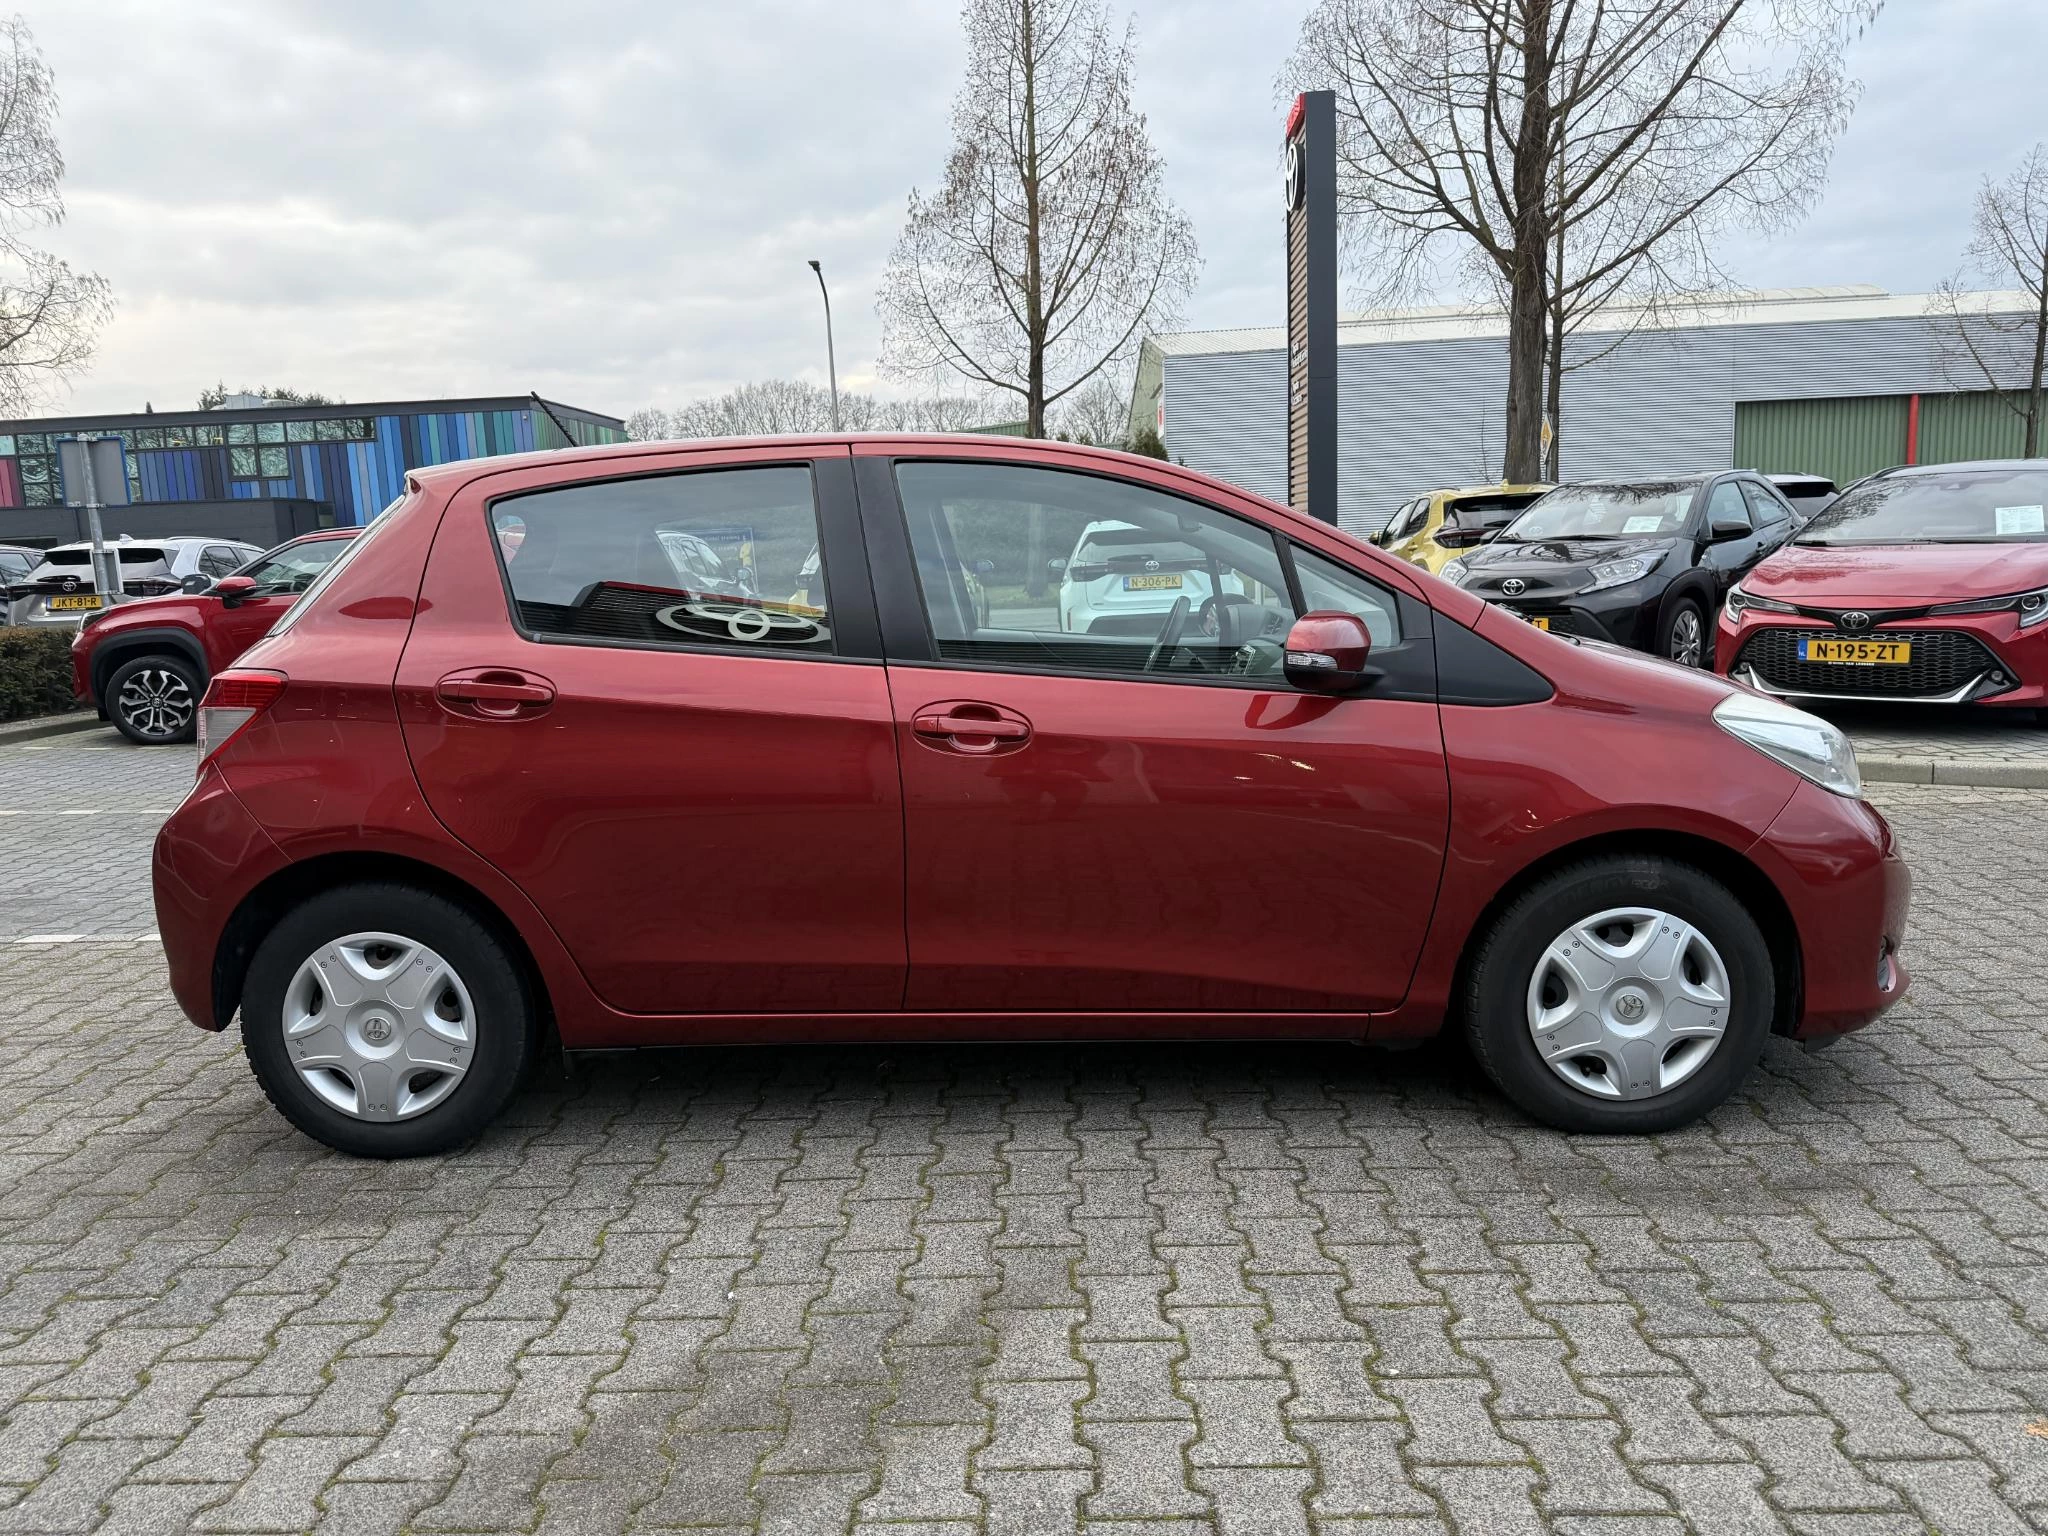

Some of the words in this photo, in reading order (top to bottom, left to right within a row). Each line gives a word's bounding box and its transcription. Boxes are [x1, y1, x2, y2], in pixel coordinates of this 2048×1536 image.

[1131, 576, 1178, 587] N-306-PK
[56, 597, 97, 608] JKT-81-R
[1816, 643, 1899, 660] N-195-ZT
